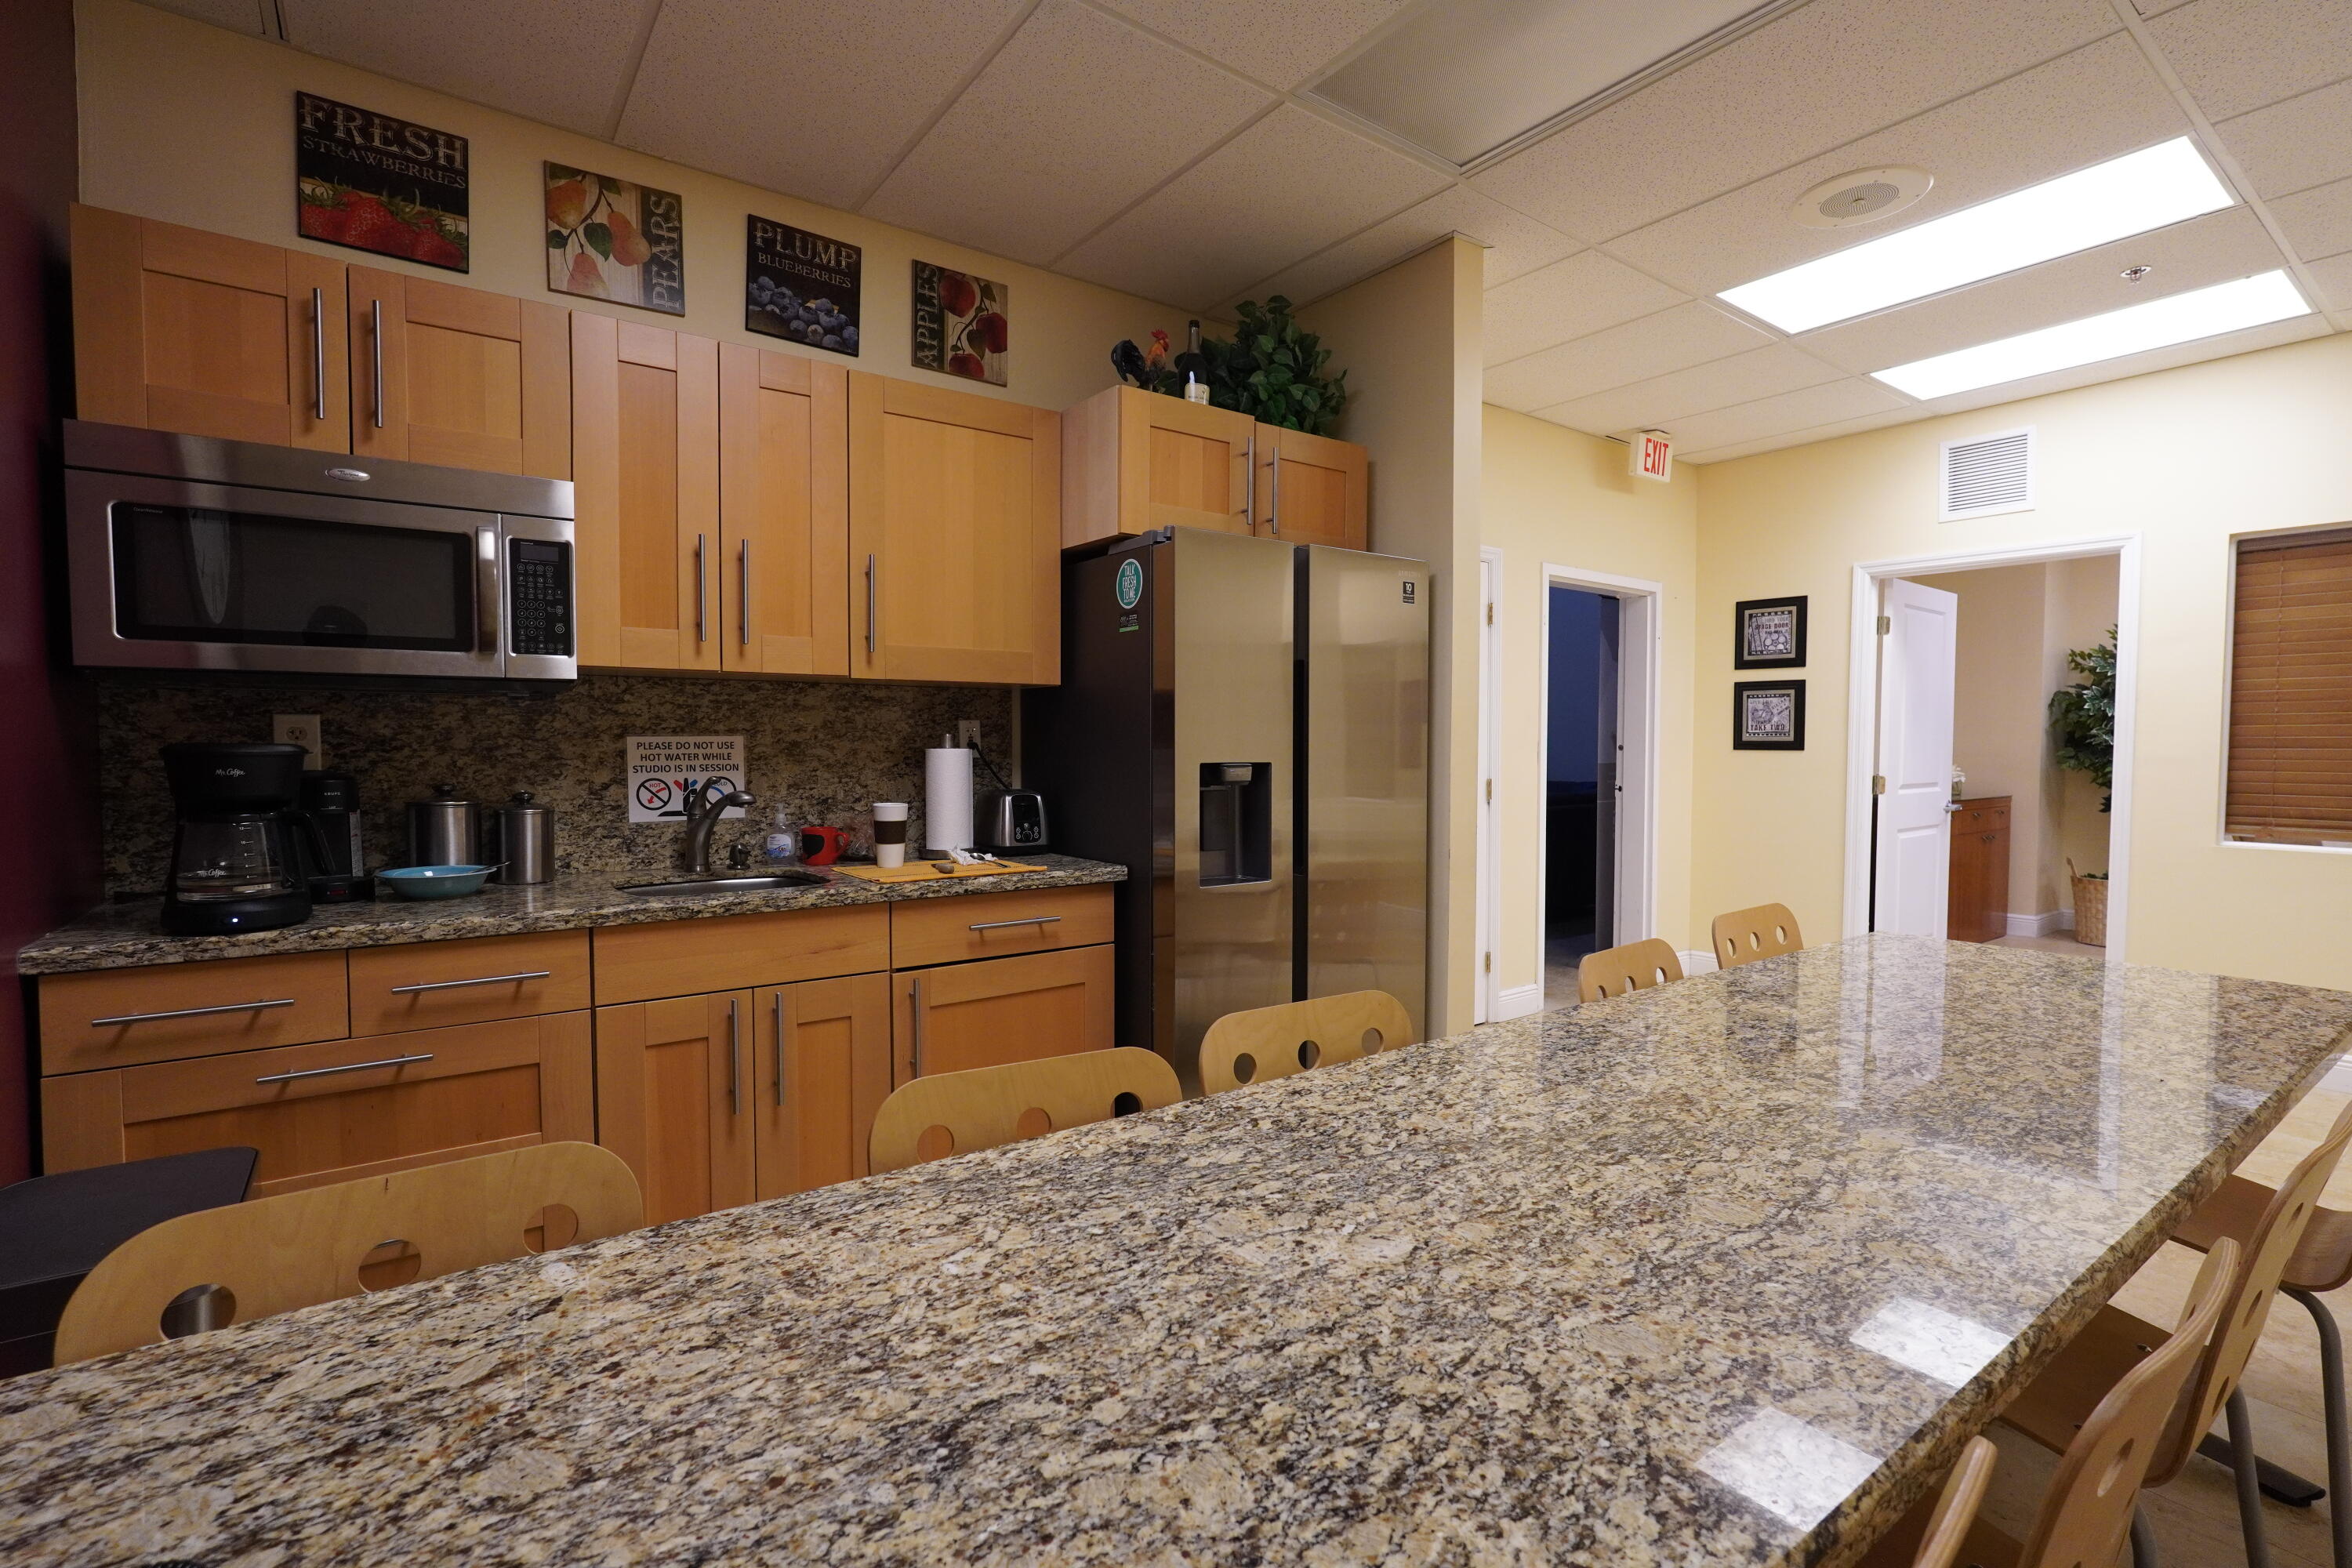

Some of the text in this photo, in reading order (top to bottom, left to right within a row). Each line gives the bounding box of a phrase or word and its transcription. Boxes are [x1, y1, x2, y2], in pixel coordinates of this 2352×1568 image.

[300, 96, 467, 171] FRESH
[303, 135, 466, 189] STRAWBERRIES
[650, 195, 681, 308] PEARS
[753, 222, 858, 272] PLUMP
[758, 252, 851, 288] BLUEBERRIES
[916, 264, 938, 368] APPLES
[1644, 437, 1668, 477] EXIT
[1122, 575, 1137, 590] FRESH
[1124, 564, 1135, 576] TALK
[1123, 586, 1135, 600] TO ME
[637, 742, 673, 750] PLEASE
[641, 753, 662, 762] HOT
[665, 753, 699, 761] WATER
[227, 768, 245, 777] Coffee
[699, 764, 739, 772] SESSION
